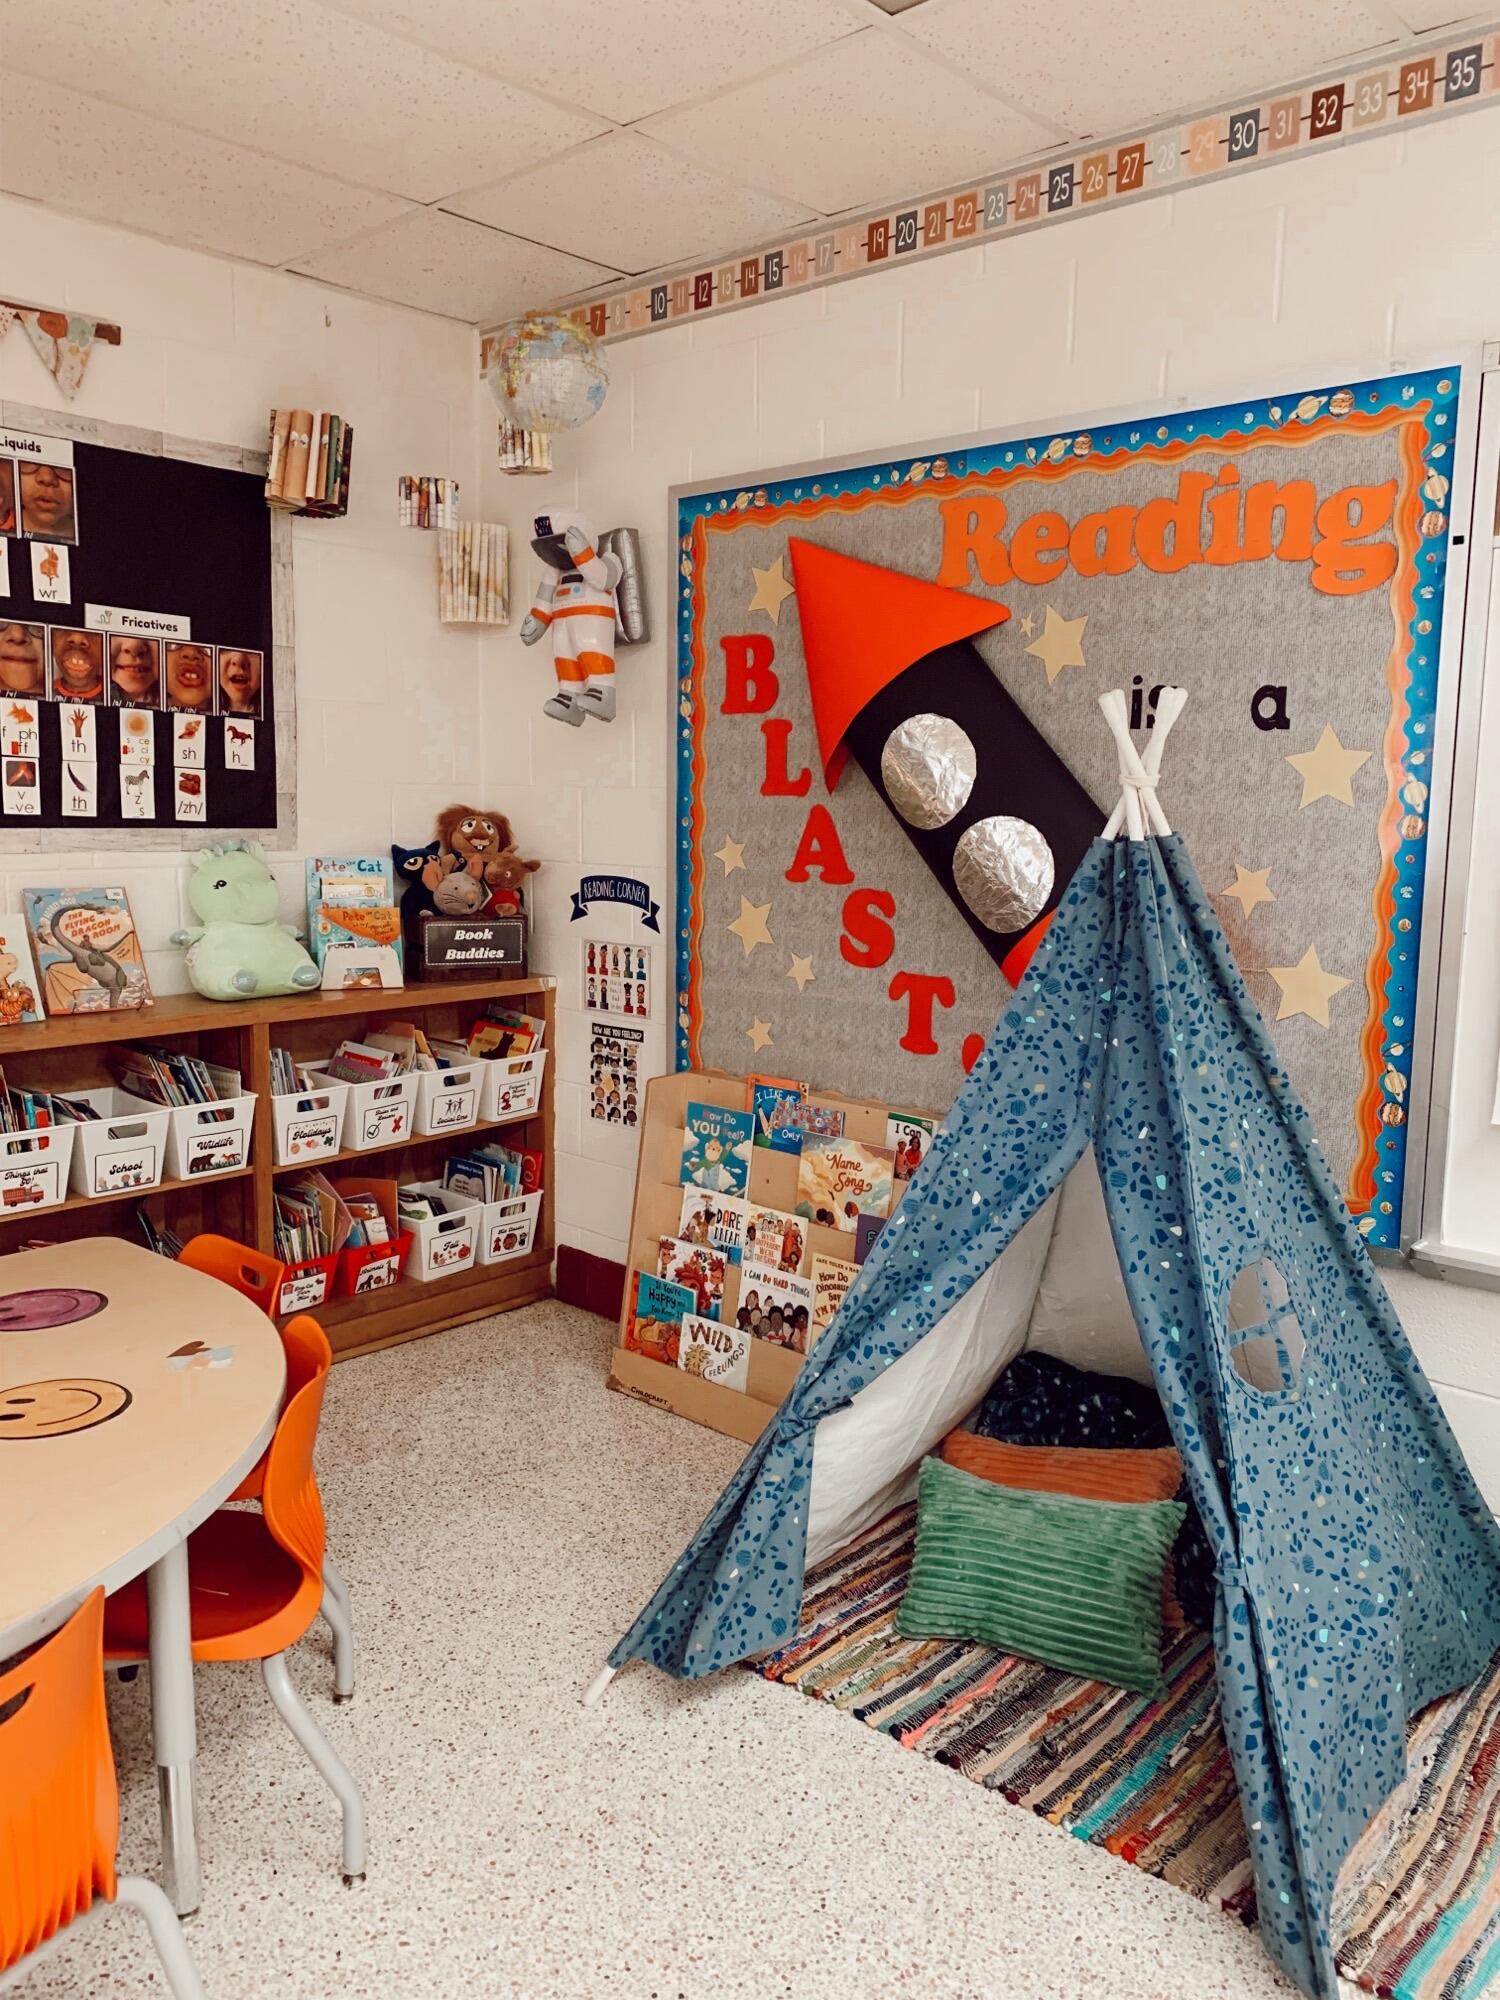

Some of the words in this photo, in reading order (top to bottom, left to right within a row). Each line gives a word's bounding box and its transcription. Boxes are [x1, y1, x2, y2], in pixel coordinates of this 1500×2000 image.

[595, 310, 602, 330] 7
[654, 292, 665, 314] 10
[699, 281, 708, 303] 12
[721, 273, 732, 295] 13
[745, 265, 756, 290] 14
[768, 258, 780, 283] 15
[793, 252, 805, 276] 16
[820, 243, 831, 268] 17
[873, 227, 885, 253] 19
[898, 219, 915, 247] 20
[929, 212, 941, 238] 21
[957, 203, 973, 229] 22
[987, 193, 1004, 221] 23
[1018, 184, 1036, 212] 24
[1052, 172, 1070, 203] 25
[1086, 163, 1104, 193] 26
[1121, 153, 1140, 184] 27
[1158, 142, 1176, 173] 28
[1194, 131, 1214, 162] 29
[1232, 118, 1256, 151] 30
[1275, 107, 1293, 139] 31
[1316, 94, 1338, 128] 32
[1359, 81, 1382, 117] 33
[1404, 68, 1429, 104] 34
[1450, 54, 1477, 91] 35
[936, 465, 1399, 596] Reading
[121, 616, 179, 633] Fricatives
[1251, 684, 1290, 731] a
[2, 726, 6, 738] f
[19, 728, 38, 741] ph
[138, 737, 150, 746] ce
[71, 739, 87, 753] th
[182, 747, 196, 760] sh
[17, 791, 26, 800] v
[72, 795, 88, 811] th
[177, 800, 203, 815] /zh/
[315, 859, 346, 873] Pete
[357, 860, 383, 873] Cat
[583, 880, 615, 899] READING
[617, 881, 646, 905] CORNER
[64, 915, 96, 931] FLYING
[71, 918, 111, 938] DRAGON
[454, 928, 493, 941] Book
[445, 947, 505, 960] Buddies
[755, 1092, 762, 1104] I
[764, 1088, 784, 1101] LIKE
[724, 1113, 736, 1125] Do
[292, 1127, 332, 1141] Holidays
[692, 1119, 720, 1136] YOU
[895, 1122, 900, 1133] I
[903, 1125, 922, 1138] Can
[196, 1136, 234, 1150] Wildlife
[109, 1160, 144, 1175] School
[826, 1153, 863, 1172] Name
[4, 1171, 31, 1180] Things
[33, 1167, 48, 1175] that
[833, 1172, 873, 1196] Song
[716, 1208, 743, 1230] DARE
[749, 1270, 761, 1281] CAN
[773, 1277, 789, 1290] HARD
[819, 1272, 836, 1282] How
[838, 1272, 848, 1282] Do
[816, 1283, 849, 1294] Dinosaur
[648, 1287, 676, 1309] Happy
[828, 1292, 842, 1302] Say
[690, 1322, 733, 1353] WILD
[708, 1343, 745, 1377] FEELINGS
